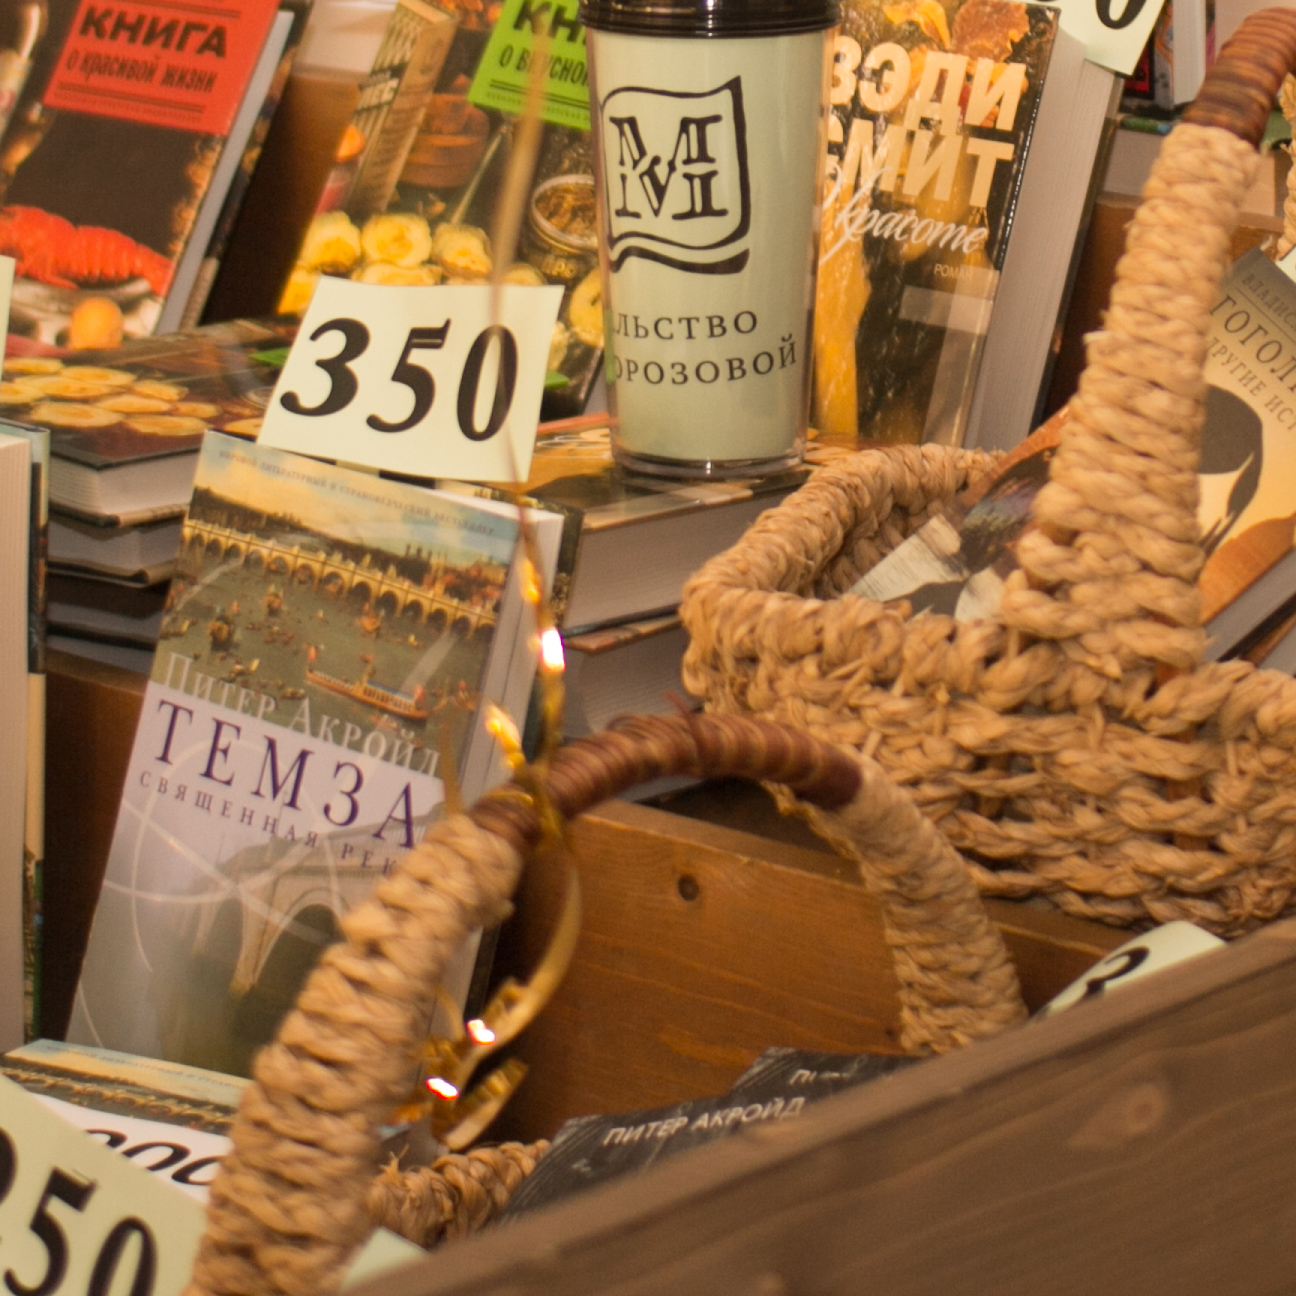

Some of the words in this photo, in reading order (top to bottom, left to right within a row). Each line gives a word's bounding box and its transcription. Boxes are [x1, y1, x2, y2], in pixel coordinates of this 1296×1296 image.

[78, 5, 227, 59] КНИГА
[279, 316, 519, 442] 350
[163, 651, 278, 720] ПИТЕР
[285, 696, 441, 778] АКРОЙД
[139, 769, 319, 849] СВЯЩЕННАЯ
[155, 698, 416, 850] ТЕМЗА
[602, 1115, 689, 1147] ПИТЕР
[690, 1095, 807, 1132] АКРОЙД
